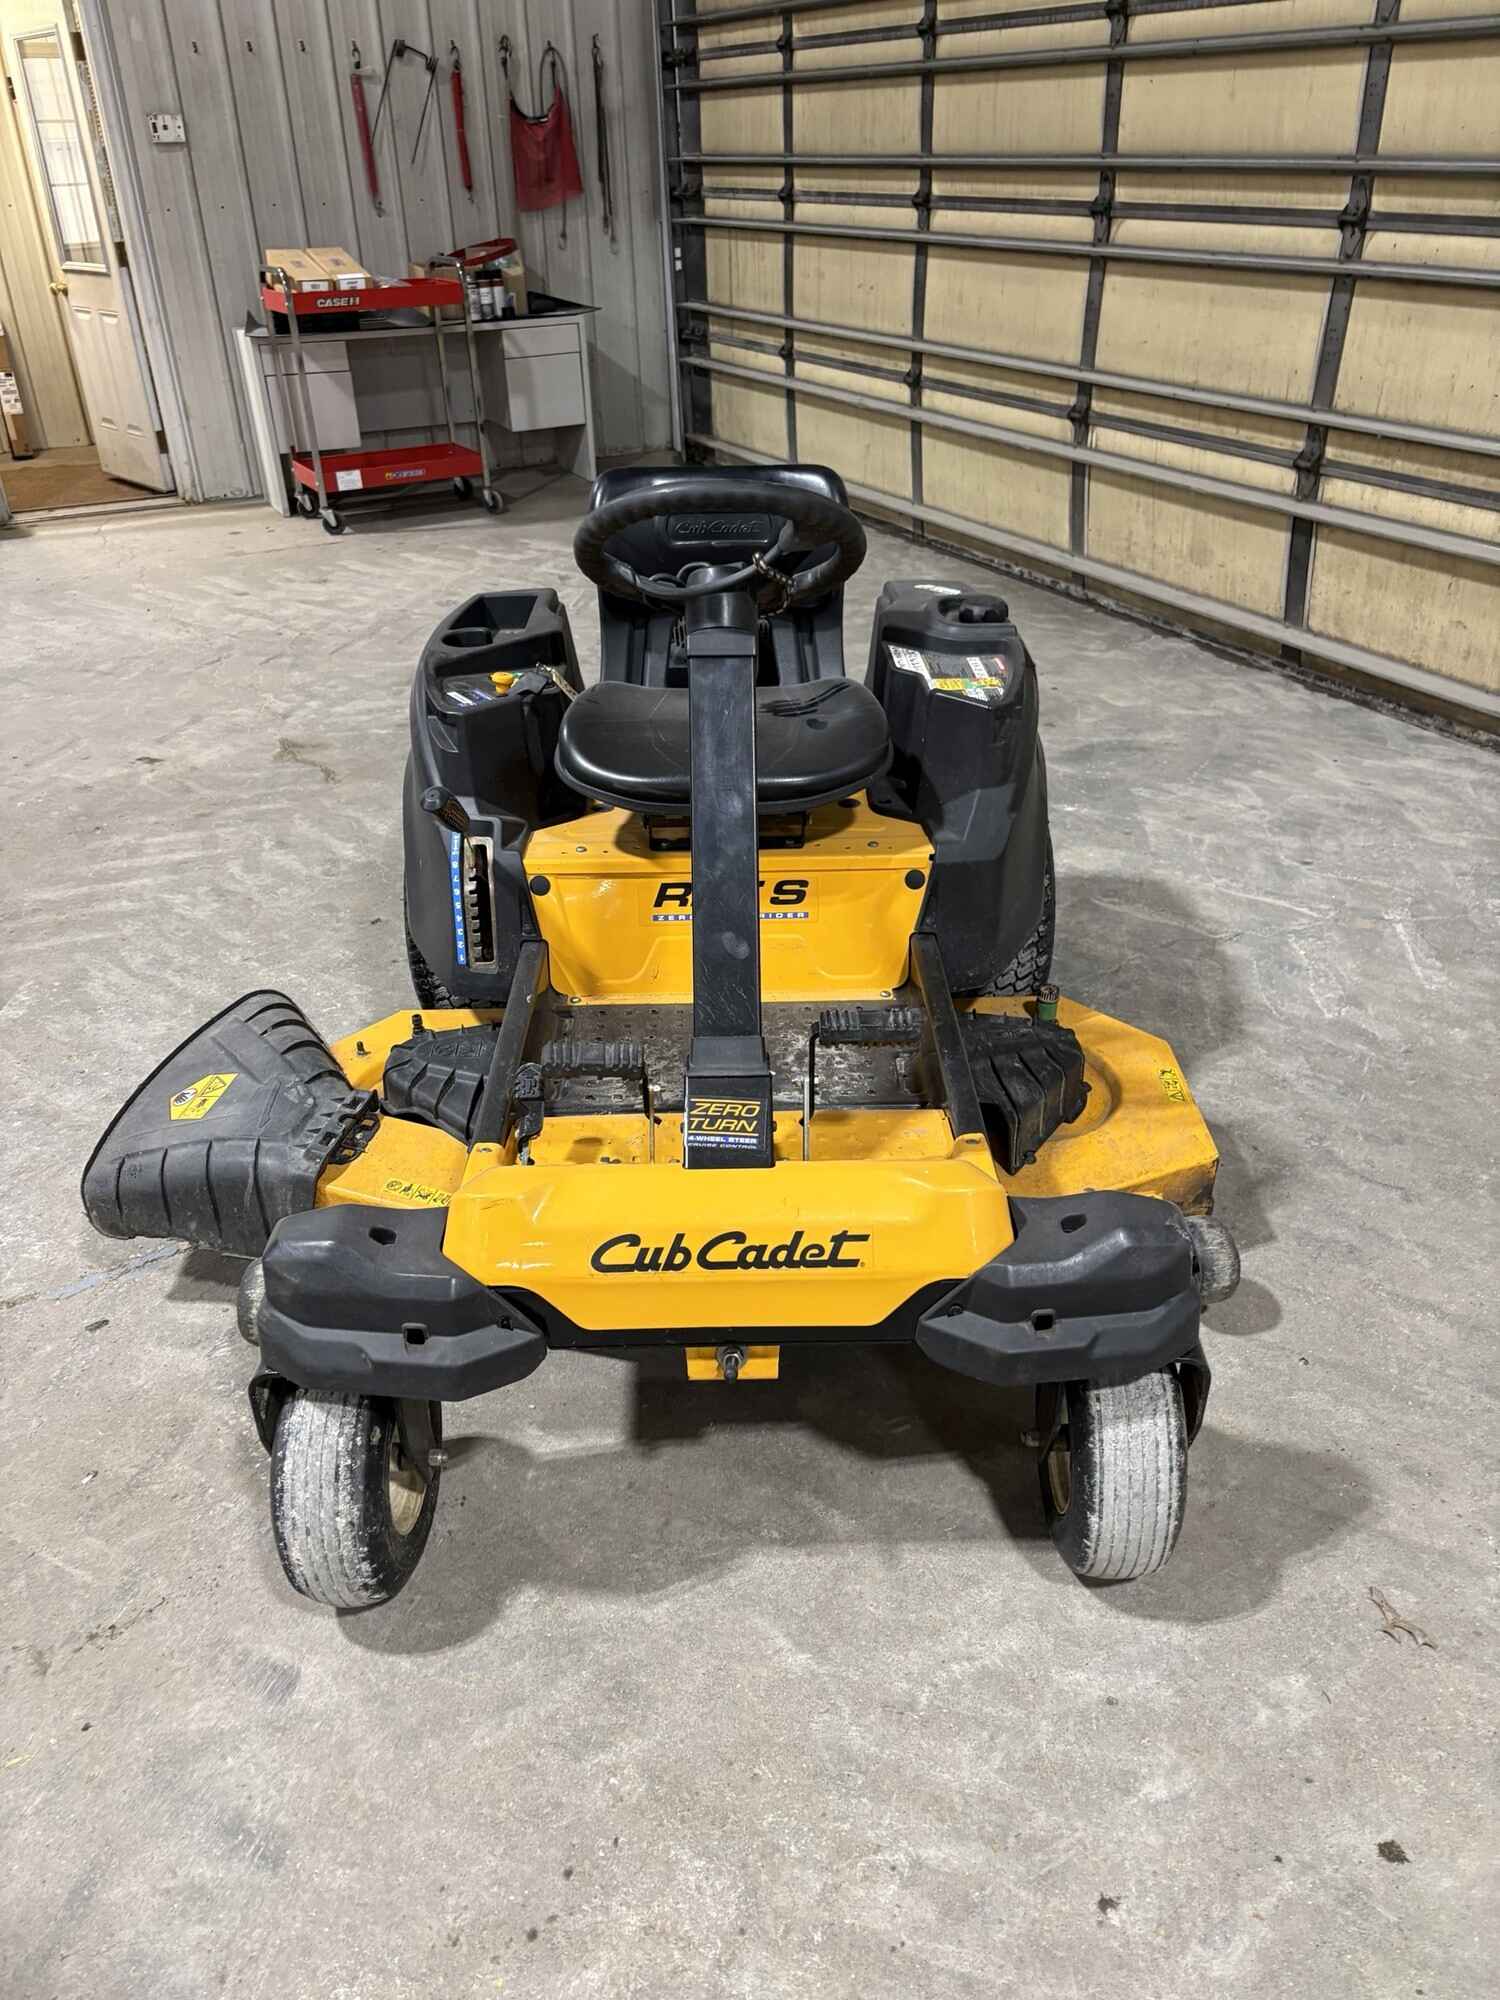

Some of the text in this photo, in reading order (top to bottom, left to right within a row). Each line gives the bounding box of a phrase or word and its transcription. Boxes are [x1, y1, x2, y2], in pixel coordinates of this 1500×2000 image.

[770, 880, 809, 905] S
[690, 1103, 760, 1117] ZERO
[689, 1118, 757, 1132] TURN
[688, 1135, 727, 1143] 4-WHEEL
[591, 1230, 871, 1273] Cub Cadet
